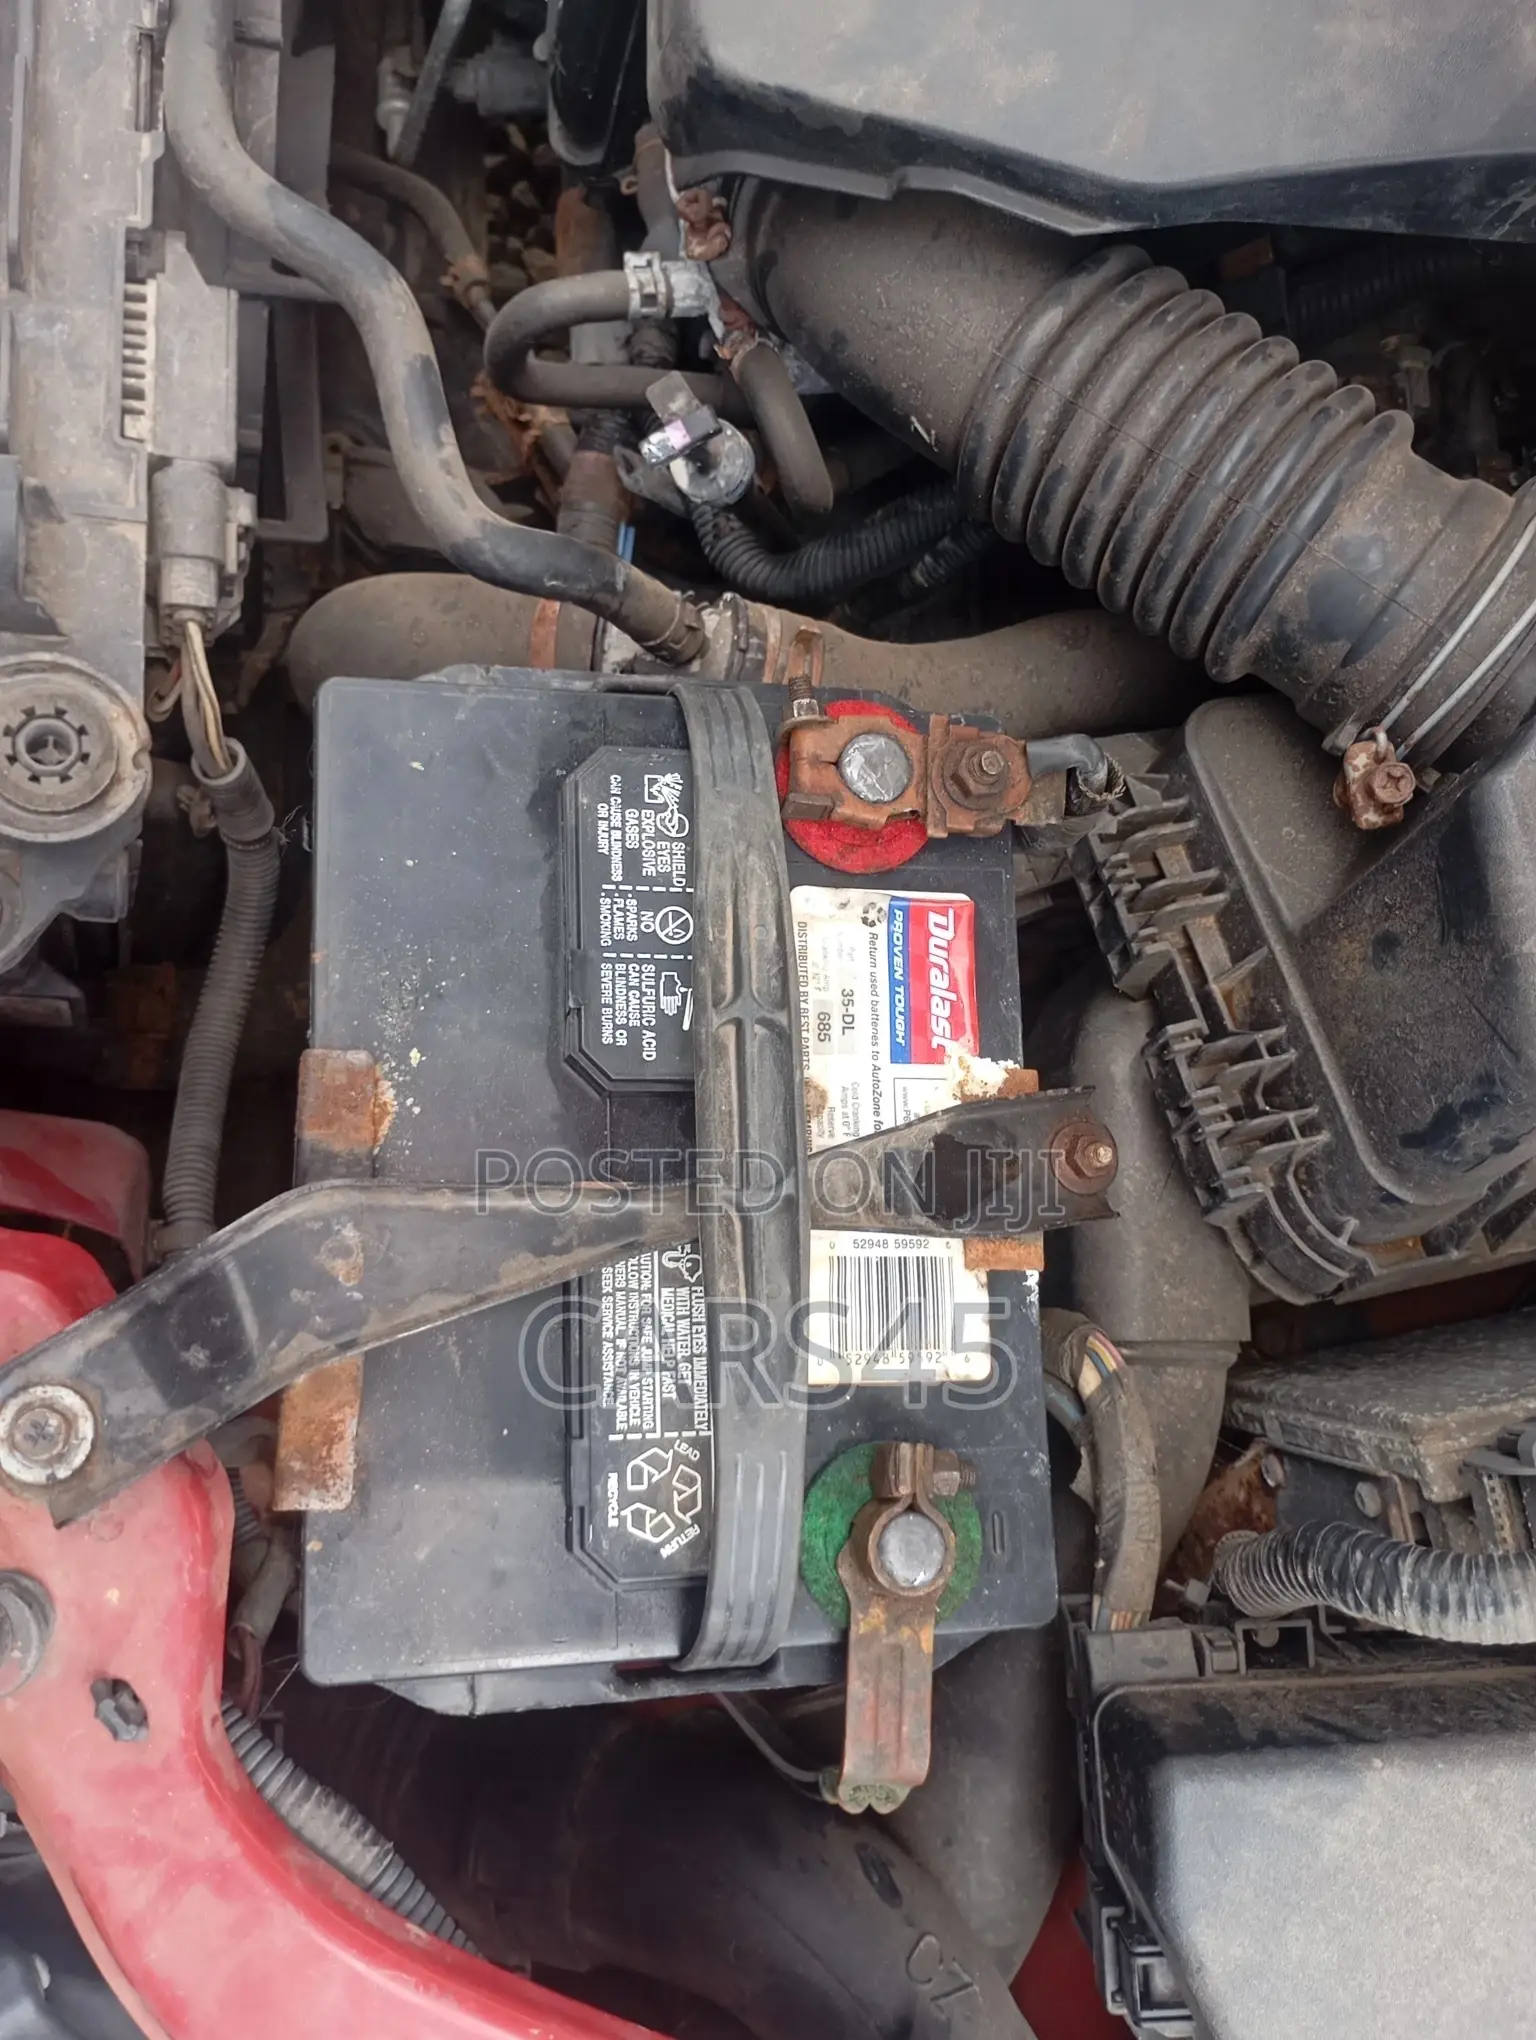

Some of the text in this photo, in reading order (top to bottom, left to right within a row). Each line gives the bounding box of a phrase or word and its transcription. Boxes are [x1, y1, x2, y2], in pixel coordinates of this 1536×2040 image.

[597, 802, 609, 855] OR INJURY
[610, 774, 622, 882] CAN CAUSE BLINDNESS
[625, 808, 639, 849] GASES
[642, 810, 656, 876] EXPLOSIVE
[656, 841, 671, 872] EYES
[672, 842, 686, 886] SHIELD
[600, 898, 611, 946] SMOKING
[613, 898, 624, 940] FLAMES
[626, 899, 638, 942] SPARKS
[640, 910, 654, 933] NO
[797, 922, 808, 988] DISTRIBUTED
[868, 932, 878, 968] Return
[628, 963, 640, 1027] CAN CAUSE
[799, 991, 810, 1005] BY
[870, 972, 880, 998] used
[893, 908, 906, 1046] PROVEN TOUGH
[928, 907, 958, 1050] Duralast
[600, 962, 613, 1044] SEVERE BURNS
[614, 963, 627, 1046] BLINDNESS OR
[641, 964, 656, 1061] SULFURIC ACID
[800, 1008, 810, 1034] BEST
[841, 988, 855, 1036] 35-DL
[870, 1000, 880, 1047] batteries
[817, 1012, 832, 1043] 685
[872, 1050, 881, 1061] to
[840, 1086, 850, 1108] Amps
[850, 1082, 861, 1138] Cold Cranking
[871, 1064, 882, 1117] AutoZone
[816, 1104, 826, 1139] Capacity
[827, 1107, 836, 1140] Reserve
[853, 1238, 889, 1249] 52948
[894, 1238, 930, 1249] 59592
[602, 1266, 614, 1293] SEEK
[602, 1296, 614, 1339] SERVICE
[640, 1293, 652, 1314] FOR
[676, 1286, 690, 1316] WITH
[616, 1338, 628, 1350] IF
[628, 1292, 640, 1366] INSTRUCTIONS
[640, 1317, 652, 1344] SAFE
[661, 1288, 676, 1399] MEDICAL HELP FAST
[616, 1352, 628, 1375] NOT
[629, 1368, 640, 1381] IN
[678, 1362, 692, 1386] GET
[692, 1286, 708, 1430] FLUSH EYES IMMEDIATELY
[845, 1353, 890, 1366] 52948
[616, 1376, 628, 1431] AVAILABLE
[629, 1382, 640, 1426] VEHICLE
[642, 1377, 654, 1430] STARTING
[673, 1439, 700, 1461] LEAD
[607, 1472, 620, 1528] RECYCLE
[660, 1523, 701, 1559] RETURN
